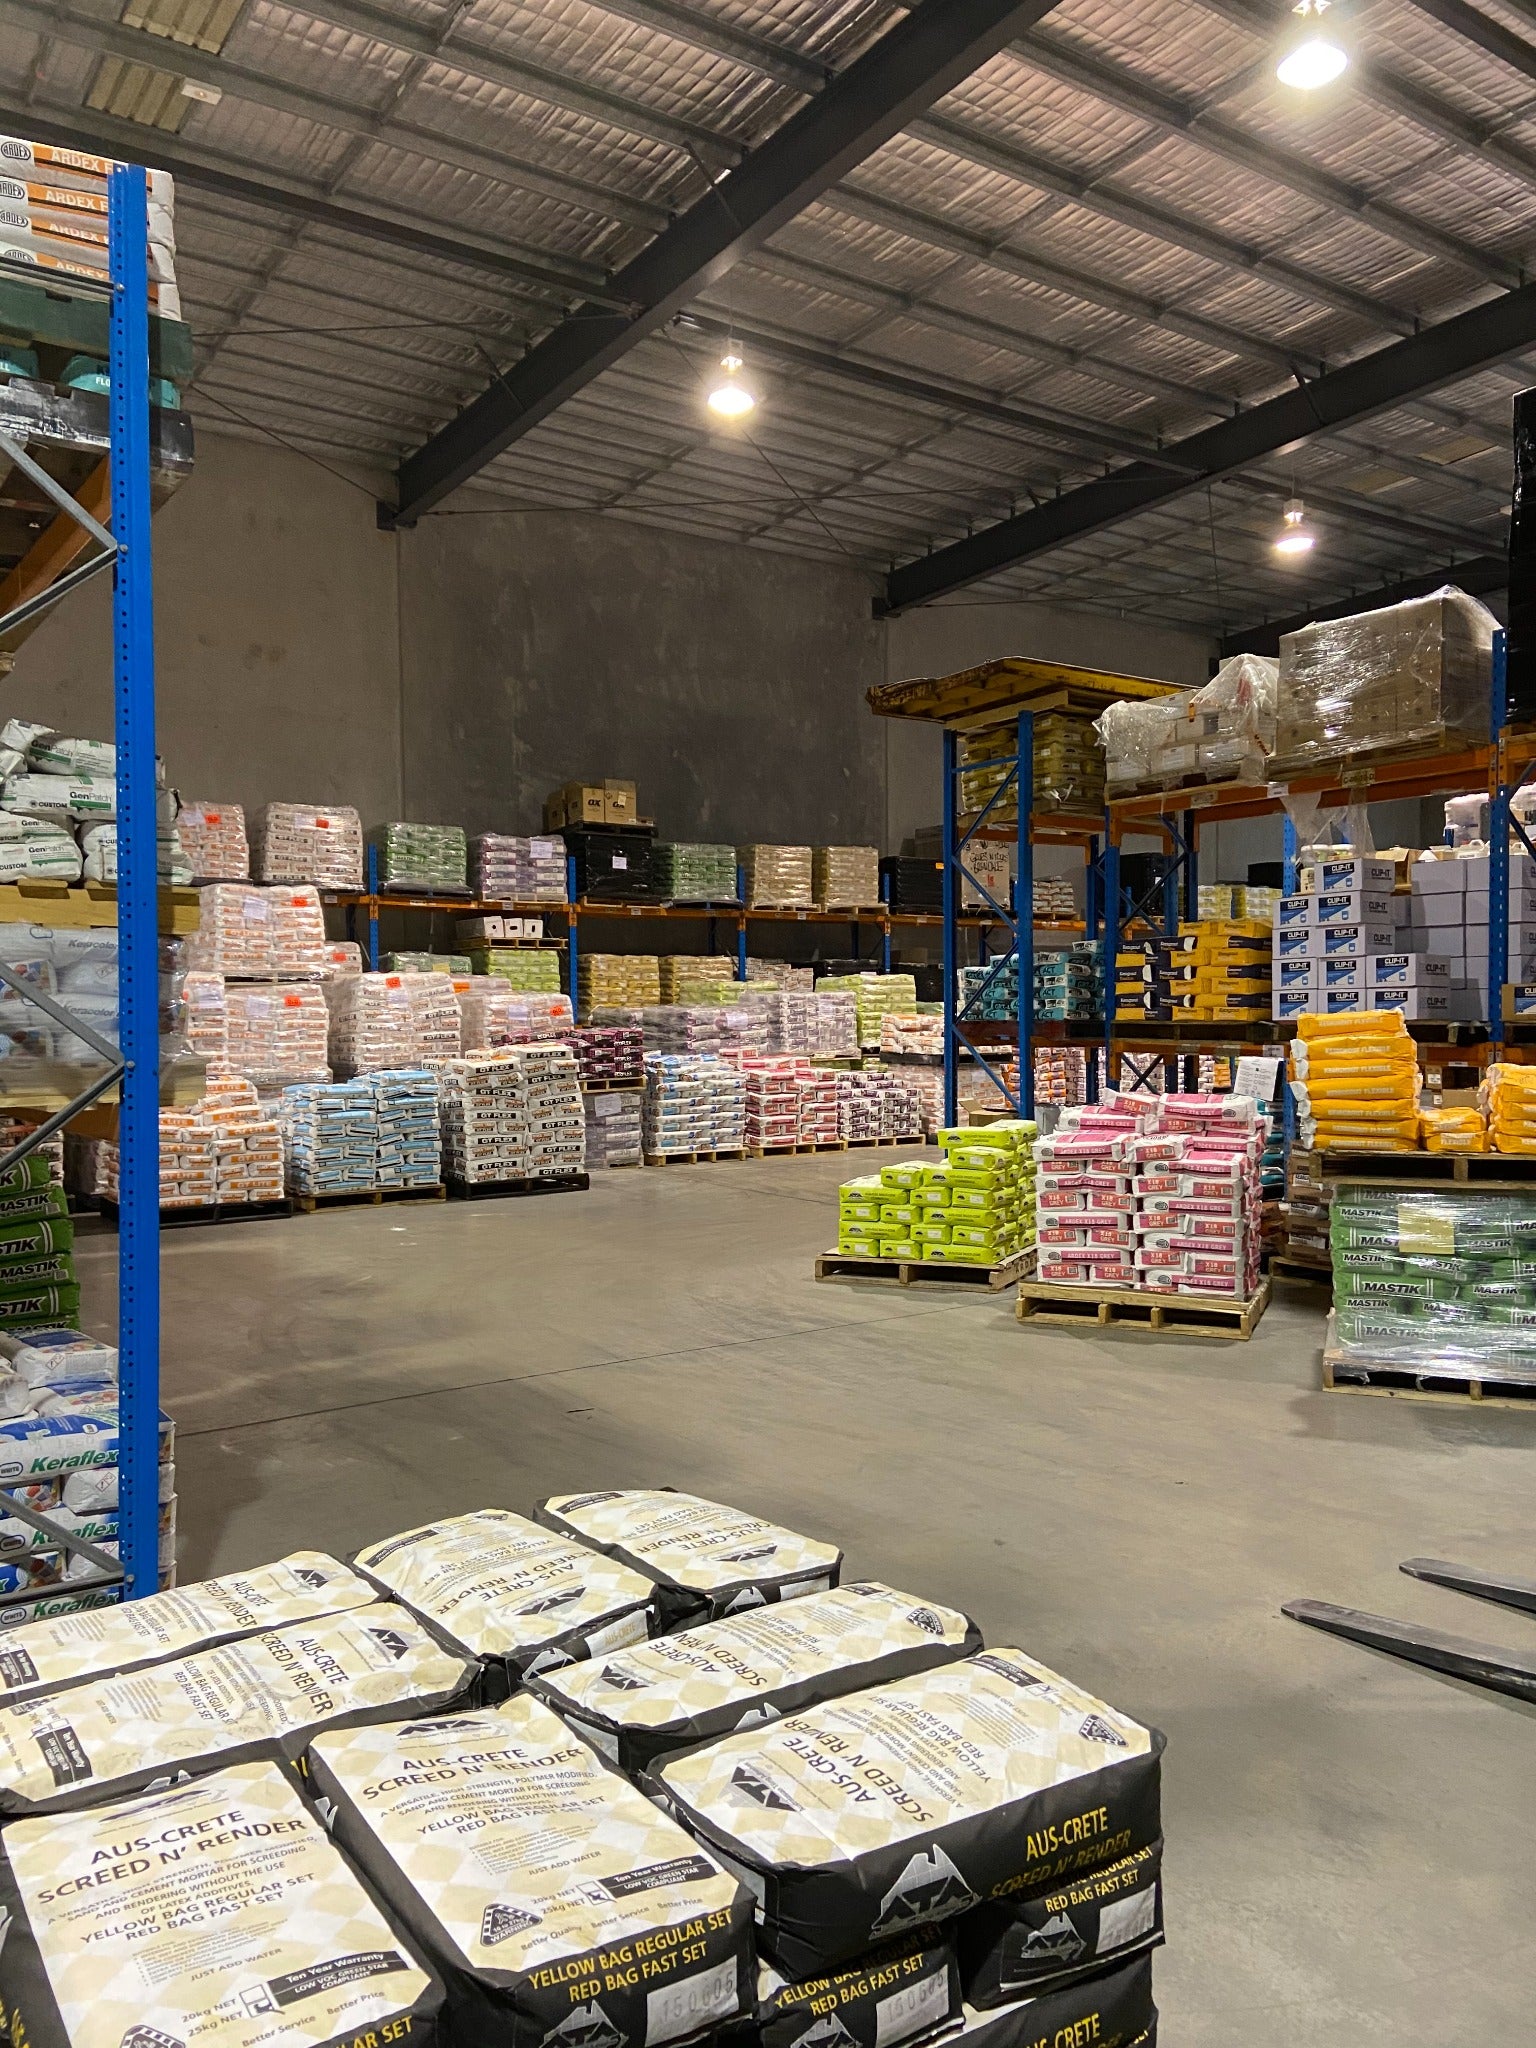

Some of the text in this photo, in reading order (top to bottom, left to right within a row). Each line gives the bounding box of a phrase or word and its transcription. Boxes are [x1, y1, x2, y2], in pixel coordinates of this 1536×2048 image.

[3, 143, 29, 158] ARDEX
[52, 151, 99, 172] ARDEX
[45, 190, 94, 209] ARDEX
[50, 223, 99, 241] ARDEX
[38, 801, 68, 809] CUSTOM
[70, 791, 112, 802] GenPatch
[1331, 865, 1353, 873] CLIP-IT
[1371, 869, 1391, 877] CLIP-IT
[1287, 900, 1306, 908] CLIP-IT
[1327, 897, 1349, 905] CLIP-IT
[1373, 934, 1392, 942] CLIP-IT
[1334, 961, 1353, 969] CLIP-IT
[1385, 957, 1406, 965] CLIP-IT
[1426, 964, 1446, 972] CLIP-IT
[1384, 992, 1405, 1000] CLIP-IT
[1427, 998, 1447, 1006] CLIP-IT
[1342, 1208, 1382, 1216] MASTIK
[1361, 1236, 1400, 1246] MAST
[1, 1259, 60, 1277] MASTIK
[1344, 1254, 1385, 1262] MASTIK
[1365, 1282, 1421, 1294] MASTIK
[1474, 1286, 1518, 1295] MASTIK
[1348, 1299, 1389, 1307] MASTIK
[30, 1449, 119, 1473] Keraflex
[33, 1592, 119, 1616] Keraflex
[296, 1638, 349, 1685] AUS-CRETE
[885, 1702, 929, 1732] REGULAR
[784, 1718, 849, 1753] RENDER
[896, 1700, 983, 1759] RED BAG FAST SET
[927, 1730, 951, 1749] BAG
[402, 1748, 529, 1770] AUS-CRETE
[783, 1737, 877, 1802] AUS-CRETE
[949, 1746, 991, 1783] YELLOW
[362, 1769, 457, 1800] SCREED
[493, 1748, 585, 1771] RENDER
[864, 1768, 933, 1822] SCREED
[91, 1810, 245, 1864] AUS-CRETE
[1027, 1807, 1108, 1862] AUS-CRETE
[38, 1820, 307, 1903] SCREED N' RENDER
[130, 1845, 306, 1899] CEMENT MORTAR FOR SCREEDING
[992, 1865, 1050, 1897] SCREED
[1076, 1829, 1131, 1869] RENDER
[123, 1861, 286, 1911] RENDERING WITHOUT THE USE
[1045, 1870, 1139, 1912] RED BAG FAST SET
[80, 1873, 316, 1944] YELLOW BAG REGULAR SET
[126, 1891, 284, 1941] RED BAG FAST SET
[528, 1908, 732, 1991] YELLOW BAG REGULAR SET
[190, 1948, 283, 1981] JUST ADD WATER
[286, 1953, 384, 1983] Ten Year Warranty
[569, 1940, 708, 2002] RED BAG FAST SET
[295, 1982, 316, 1994] LOW
[367, 1963, 388, 1974] STAR
[810, 1953, 925, 2016] RED BAG FAST SET
[181, 1999, 236, 2023] 20kg NET
[326, 1989, 385, 2015] Better Price
[187, 2011, 243, 2038] 25kg NET
[382, 2015, 414, 2043] SET
